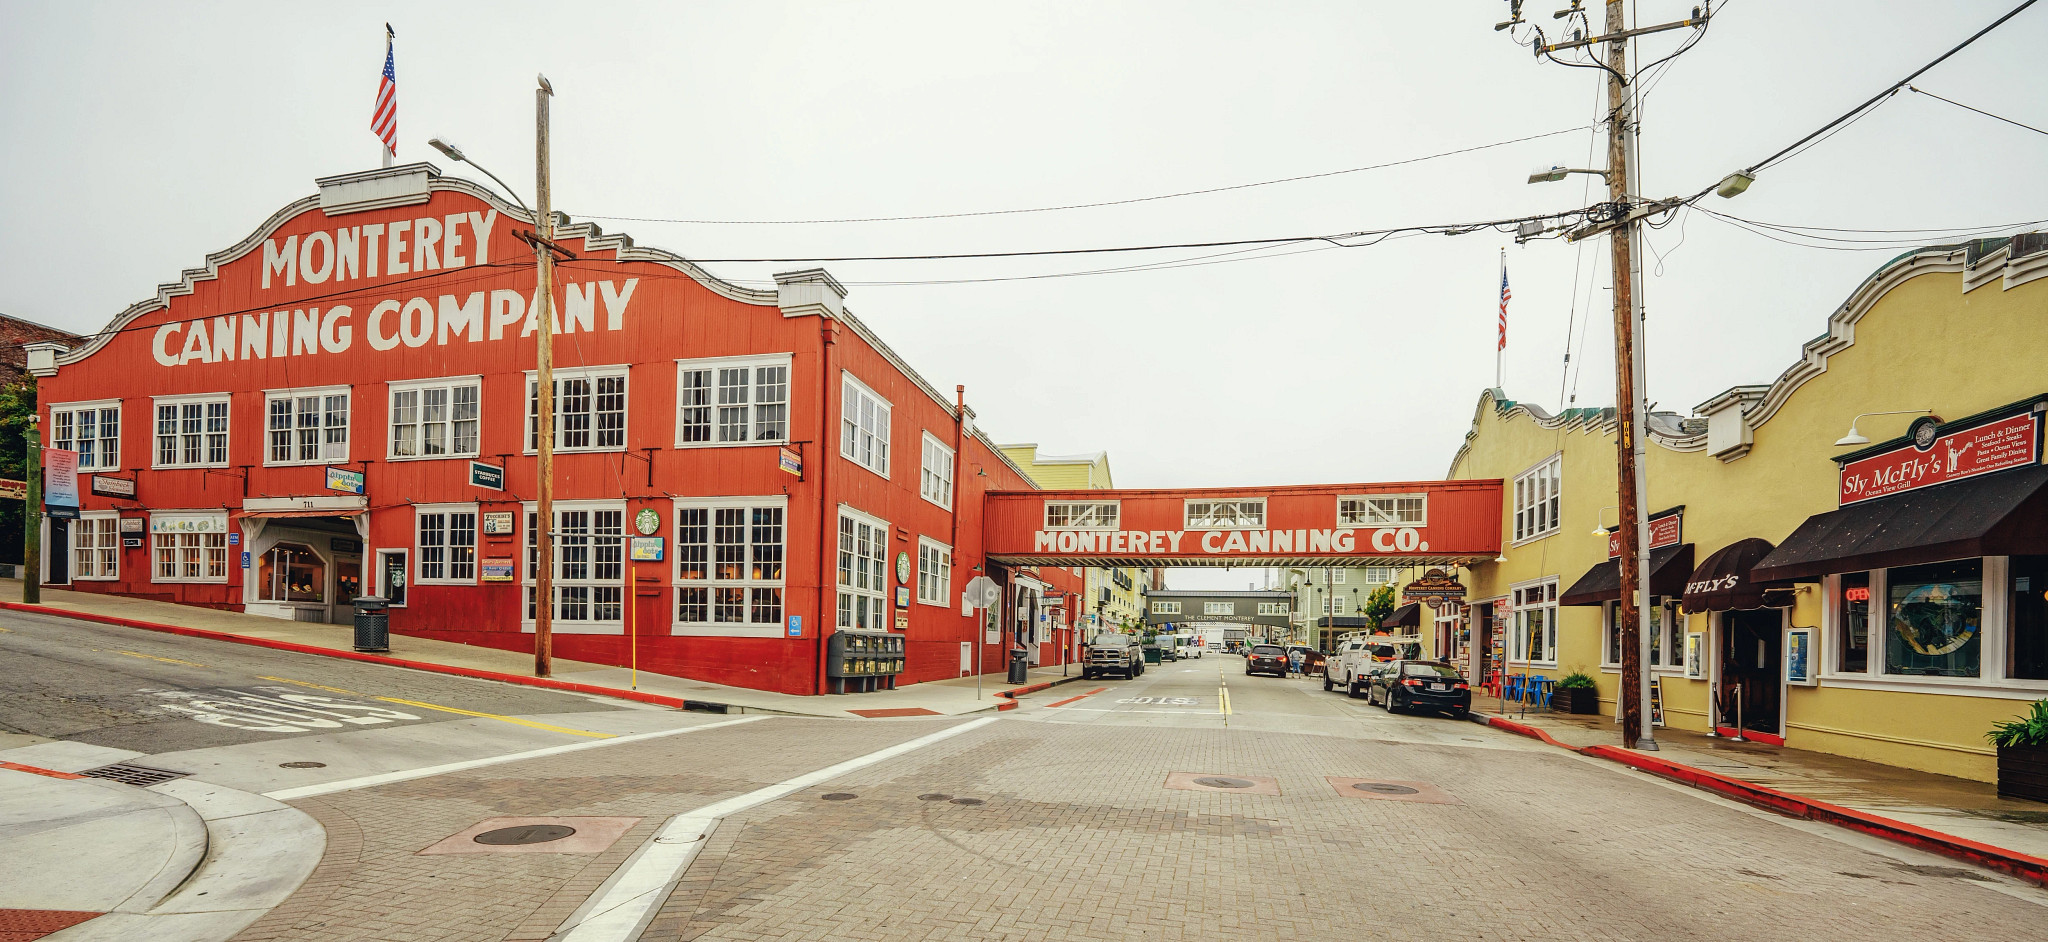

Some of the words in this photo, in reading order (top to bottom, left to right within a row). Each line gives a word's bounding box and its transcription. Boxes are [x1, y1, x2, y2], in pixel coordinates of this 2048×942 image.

[261, 209, 498, 290] MONTEREY
[151, 304, 353, 367] CANNING
[367, 278, 639, 351] COMPANY
[1975, 431, 1996, 444] Lunch
[2005, 423, 2031, 435] Dinner
[1981, 438, 2001, 448] Seafood
[2006, 433, 2023, 442] Steaks
[1990, 451, 2008, 461] Family
[2008, 448, 2027, 457] Dining
[1994, 443, 2011, 452] Ocean
[2011, 440, 2027, 448] Views
[474, 470, 500, 479] STARBUCKS
[1844, 474, 1868, 495] Sly
[1872, 454, 1942, 488] McFly's
[1865, 489, 1882, 497] Ocean
[1883, 485, 1897, 494] View
[1897, 480, 1911, 491] Grill
[1035, 530, 1184, 553] MONTEREY
[1201, 528, 1355, 553] CANNING
[1371, 527, 1429, 552] CO.
[1845, 587, 1870, 601] OPEN
